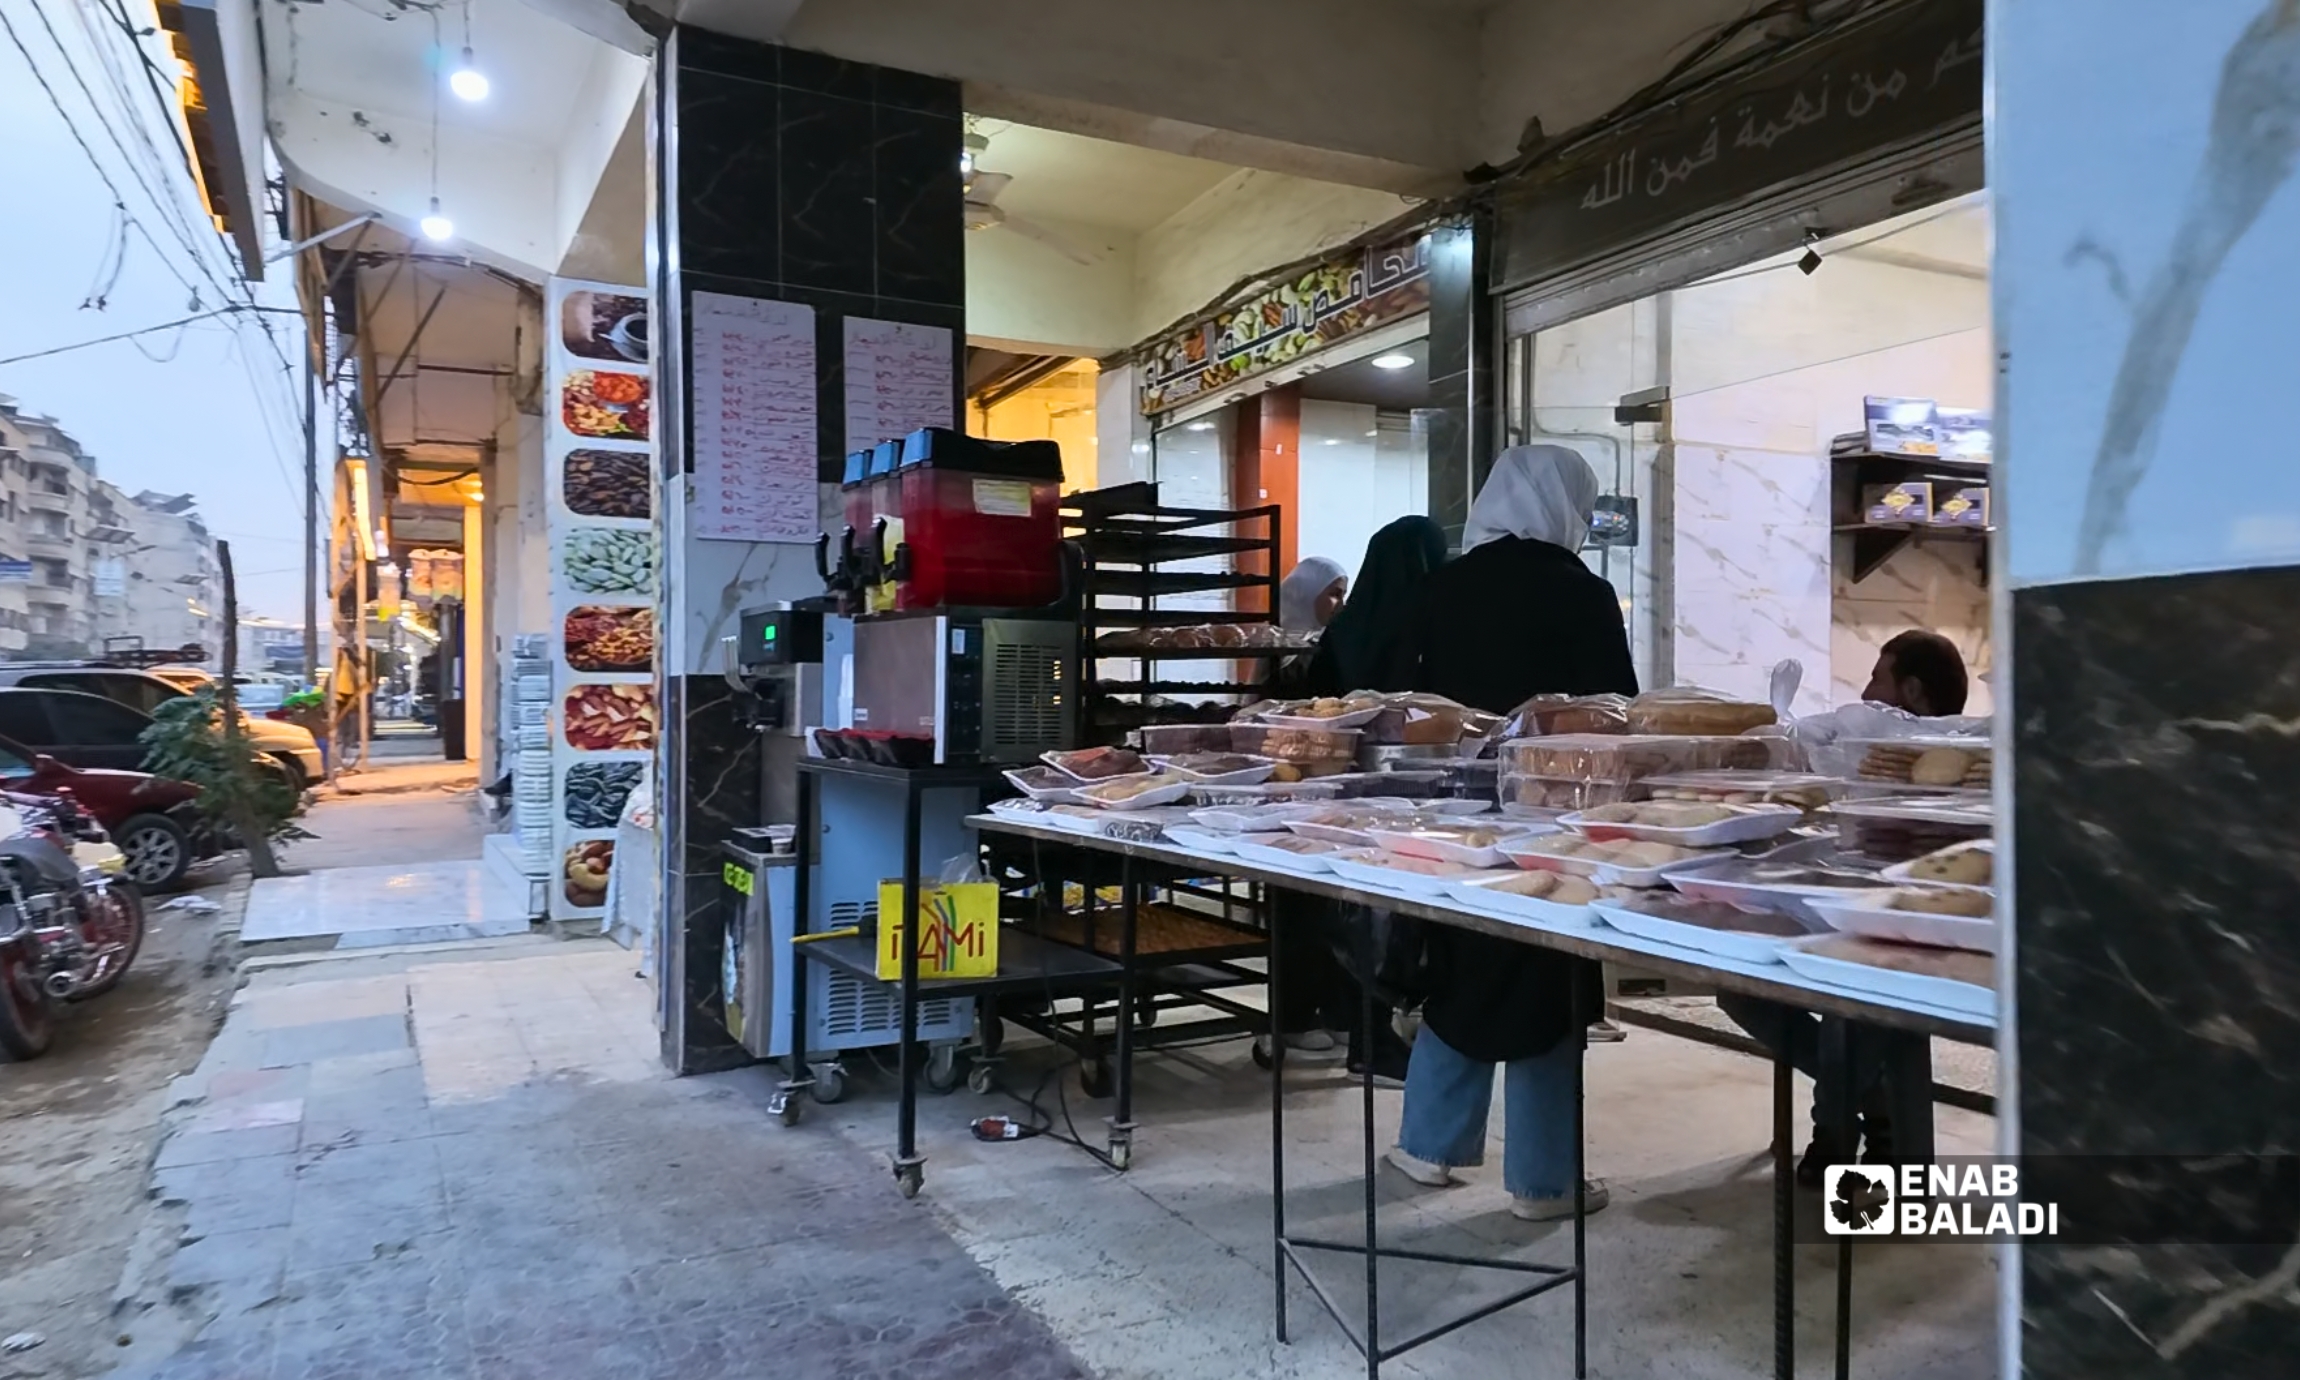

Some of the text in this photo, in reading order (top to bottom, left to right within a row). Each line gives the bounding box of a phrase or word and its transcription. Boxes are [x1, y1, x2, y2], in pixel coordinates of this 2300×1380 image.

[1734, 74, 1829, 149] نعمة
[1846, 68, 1907, 117] من
[1580, 148, 1636, 210] الله
[1646, 117, 1719, 197] فمن
